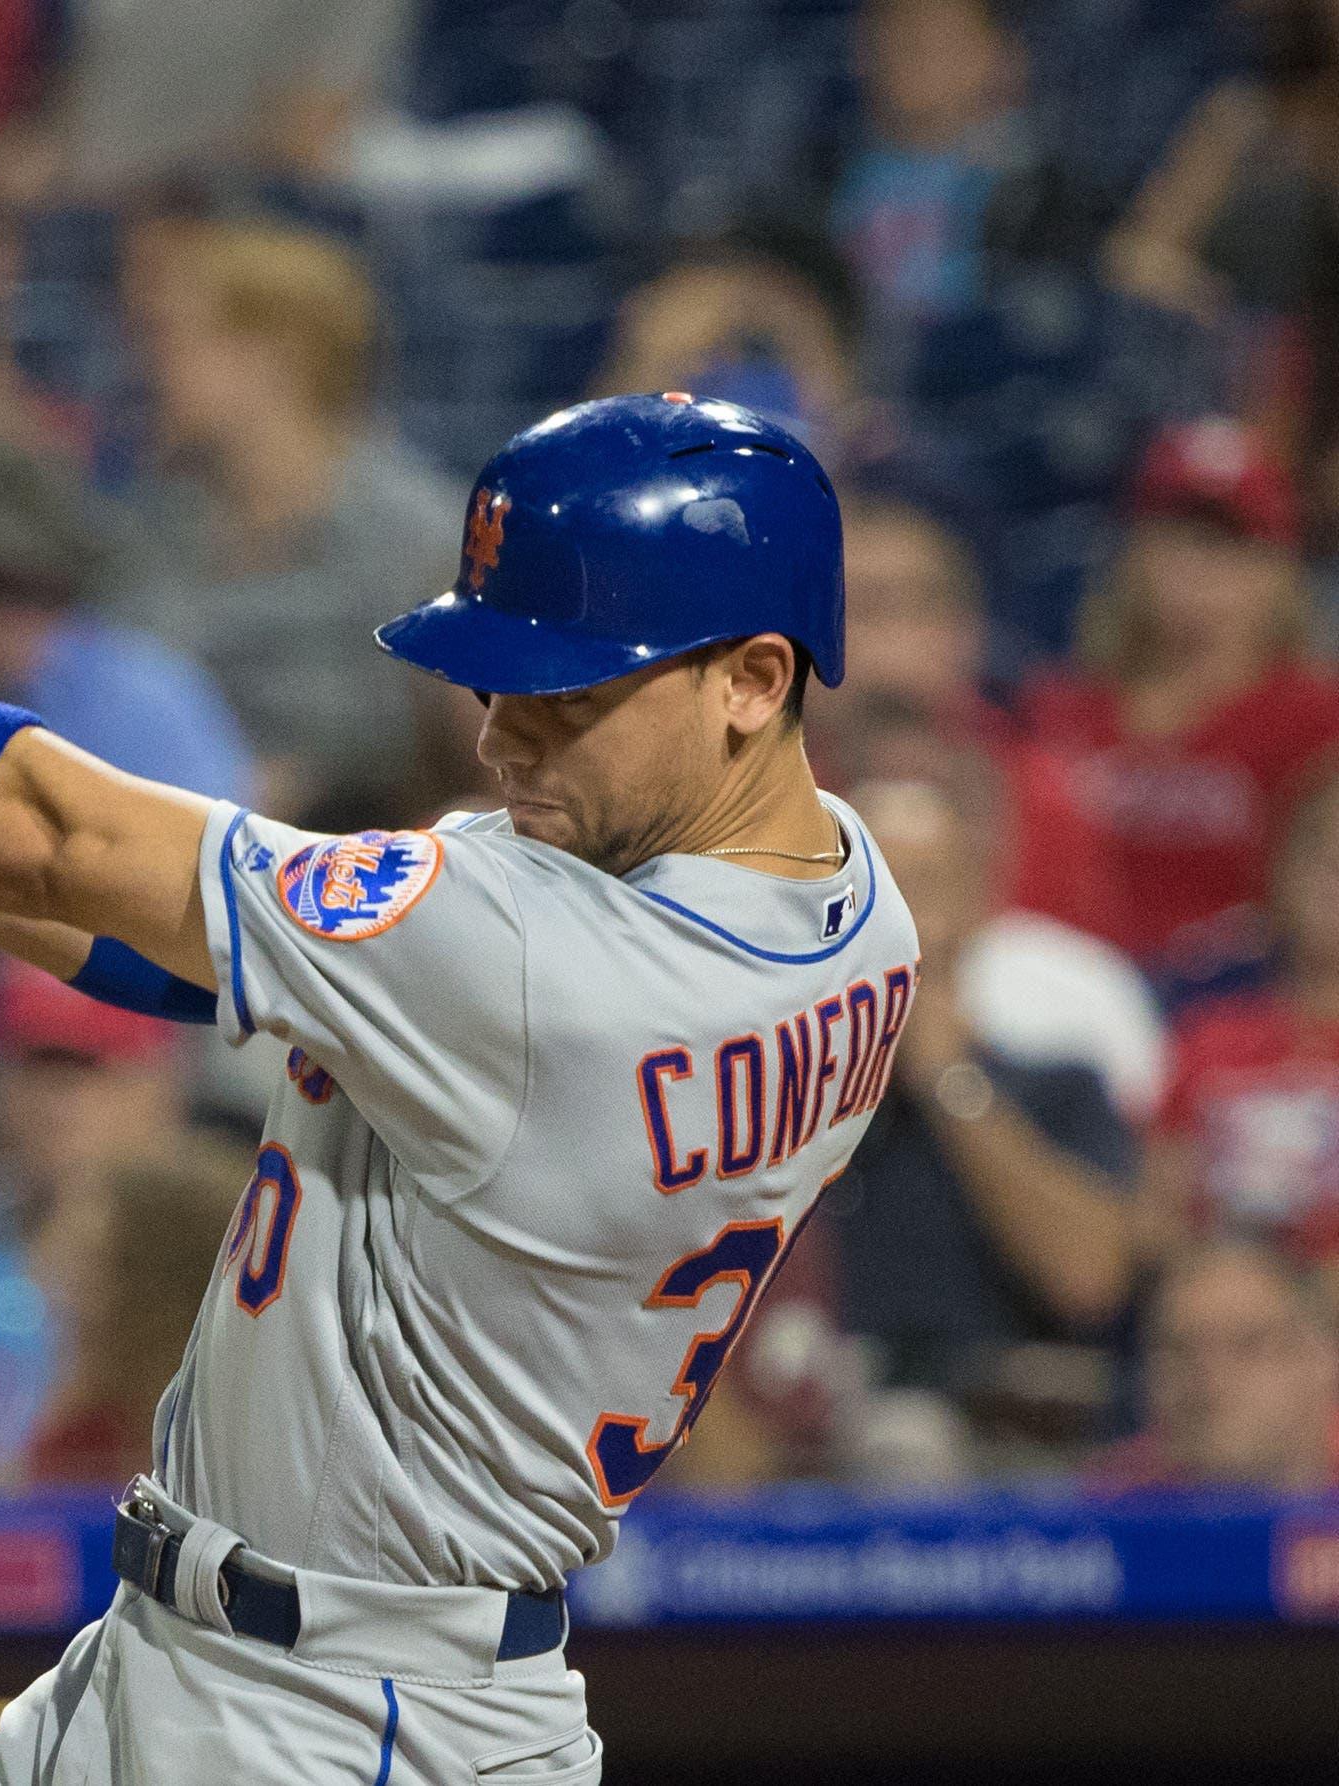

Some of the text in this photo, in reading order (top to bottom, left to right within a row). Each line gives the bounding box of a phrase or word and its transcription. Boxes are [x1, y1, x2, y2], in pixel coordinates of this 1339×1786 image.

[321, 839, 386, 912] Mets
[636, 955, 921, 1194] CONFOR
[585, 1167, 844, 1508] 3
